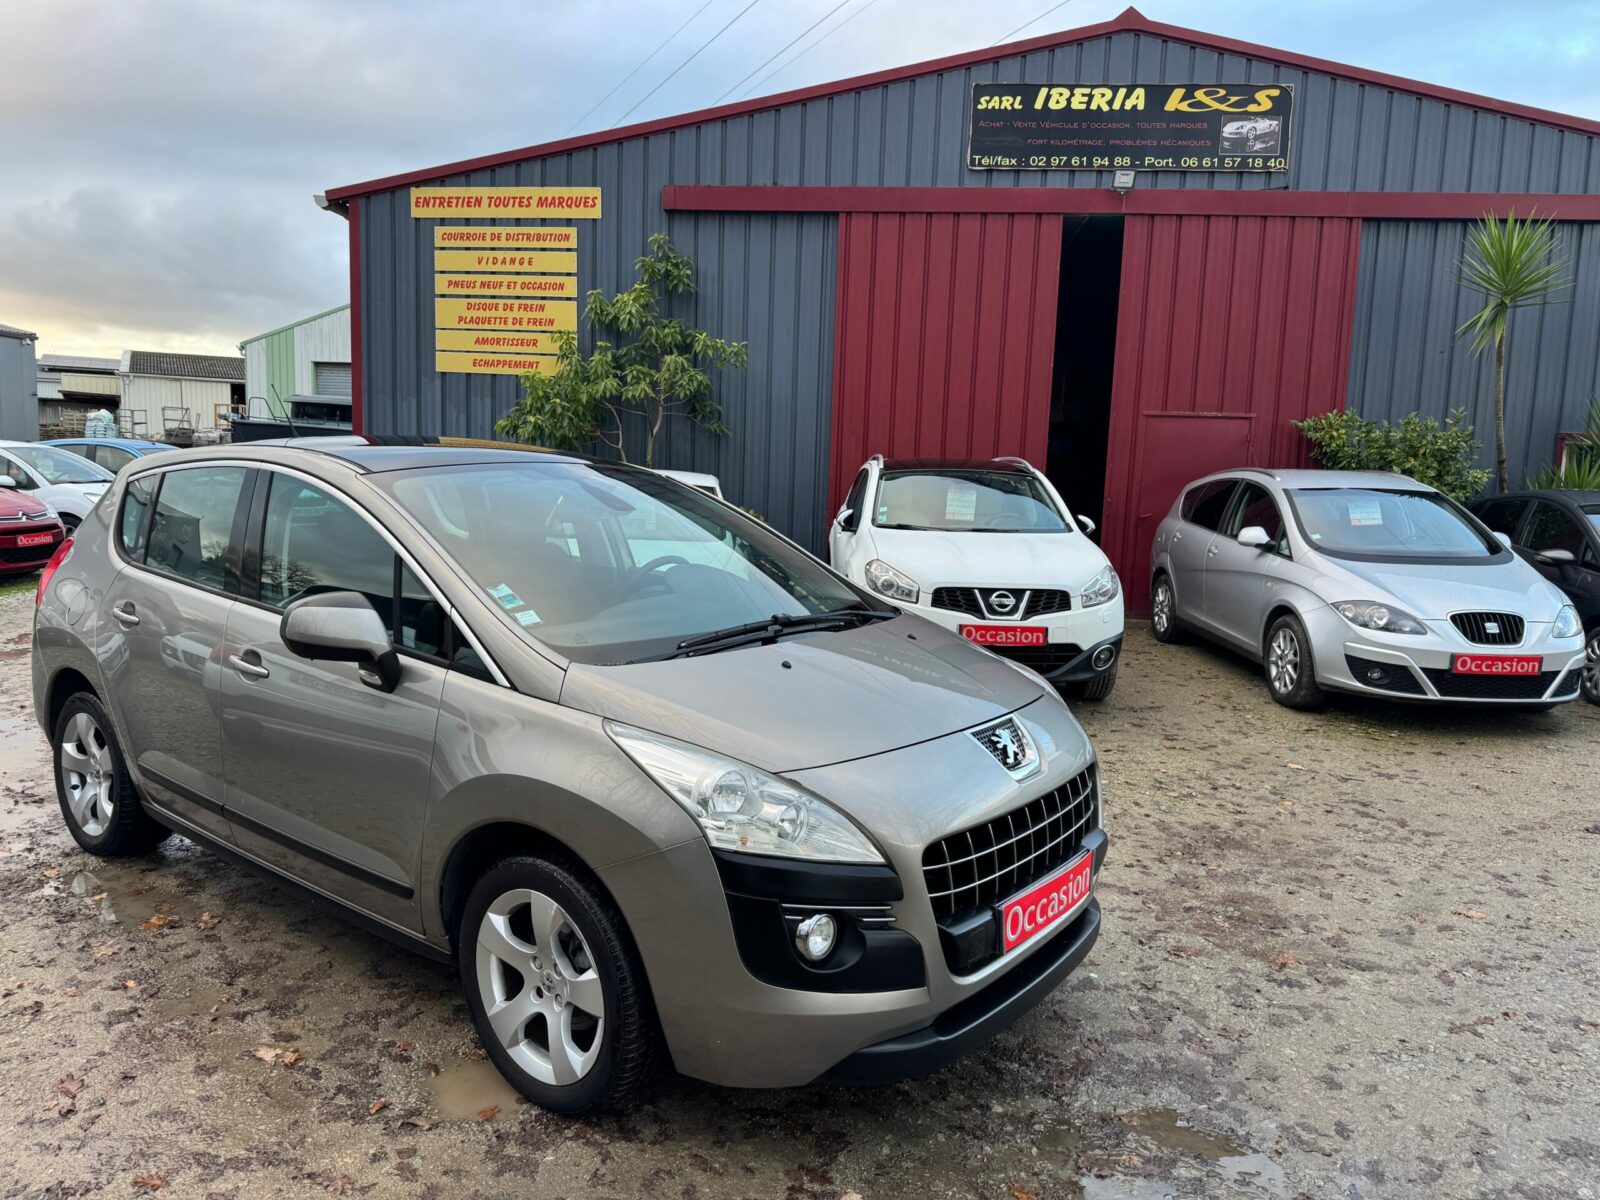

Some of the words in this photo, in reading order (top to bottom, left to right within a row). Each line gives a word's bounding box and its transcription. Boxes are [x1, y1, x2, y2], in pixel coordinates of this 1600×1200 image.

[977, 95, 1023, 110] SARL
[1033, 87, 1145, 112] IBERIA
[972, 155, 1017, 166] Tél/fax
[1029, 156, 1047, 166] 02
[1050, 156, 1067, 167] 97
[1071, 157, 1087, 167] 61
[1092, 156, 1109, 167] 94
[1113, 157, 1131, 167] 88
[1144, 157, 1176, 167] Port.
[1181, 157, 1198, 168] 06
[1202, 157, 1218, 168] 61
[1224, 158, 1241, 168] 57
[1247, 158, 1263, 168] 18
[1266, 158, 1285, 168] 40
[414, 196, 483, 209] ENTRETIEN
[487, 196, 533, 209] TOUTES
[536, 196, 598, 209] MARQUES
[441, 232, 487, 242] COURROIE
[489, 232, 502, 242] DE
[505, 232, 571, 242] DISTRIBUTION
[447, 280, 477, 290] PNEUS
[479, 280, 504, 290] NEUF
[506, 281, 518, 290] ET
[520, 281, 565, 292] OCCASION
[466, 302, 500, 312] DISQUE
[502, 303, 515, 312] DE
[517, 303, 546, 313] FREIN
[457, 315, 509, 325] PLAQUETTE
[511, 316, 525, 326] DE
[526, 317, 555, 327] FREIN
[474, 336, 539, 348] AMORTISSEUR
[472, 358, 540, 370] ECHAPPEMENT
[17, 534, 53, 545] Occasion
[962, 626, 1044, 644] Occasion
[1456, 656, 1539, 673] Occasion
[1006, 867, 1090, 942] Occasion
